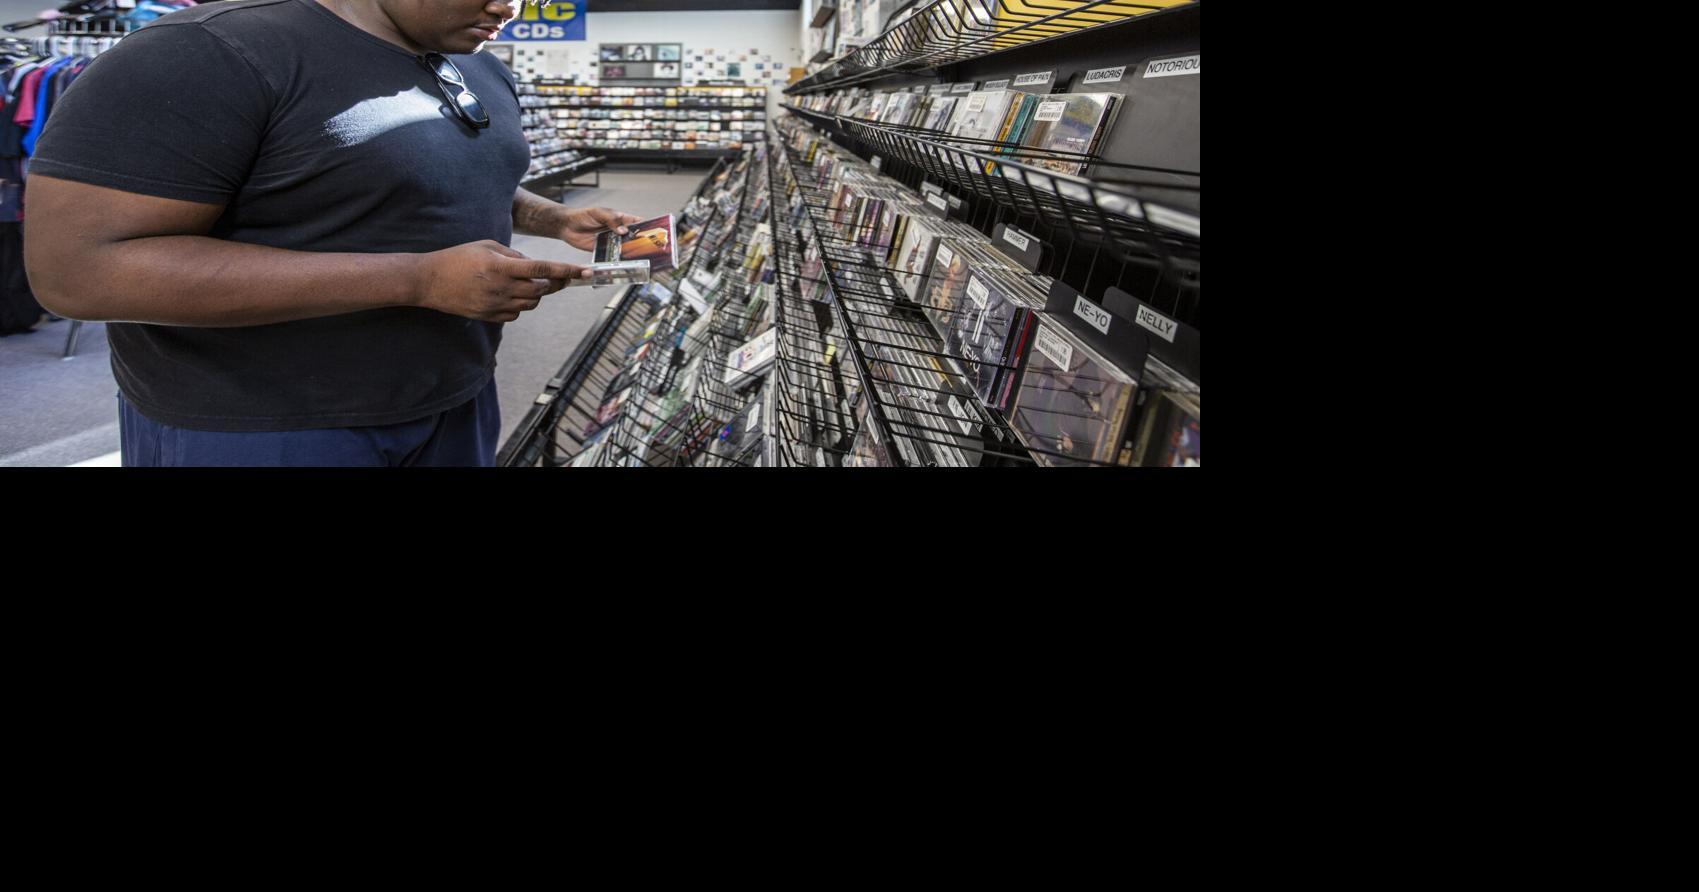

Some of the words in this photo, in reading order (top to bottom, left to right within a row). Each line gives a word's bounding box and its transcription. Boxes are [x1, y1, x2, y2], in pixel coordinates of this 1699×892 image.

[511, 22, 565, 39] CDs
[1086, 67, 1122, 81] LUDACRIS
[1077, 300, 1109, 328] NE-YO
[1139, 309, 1174, 333] NELLY
